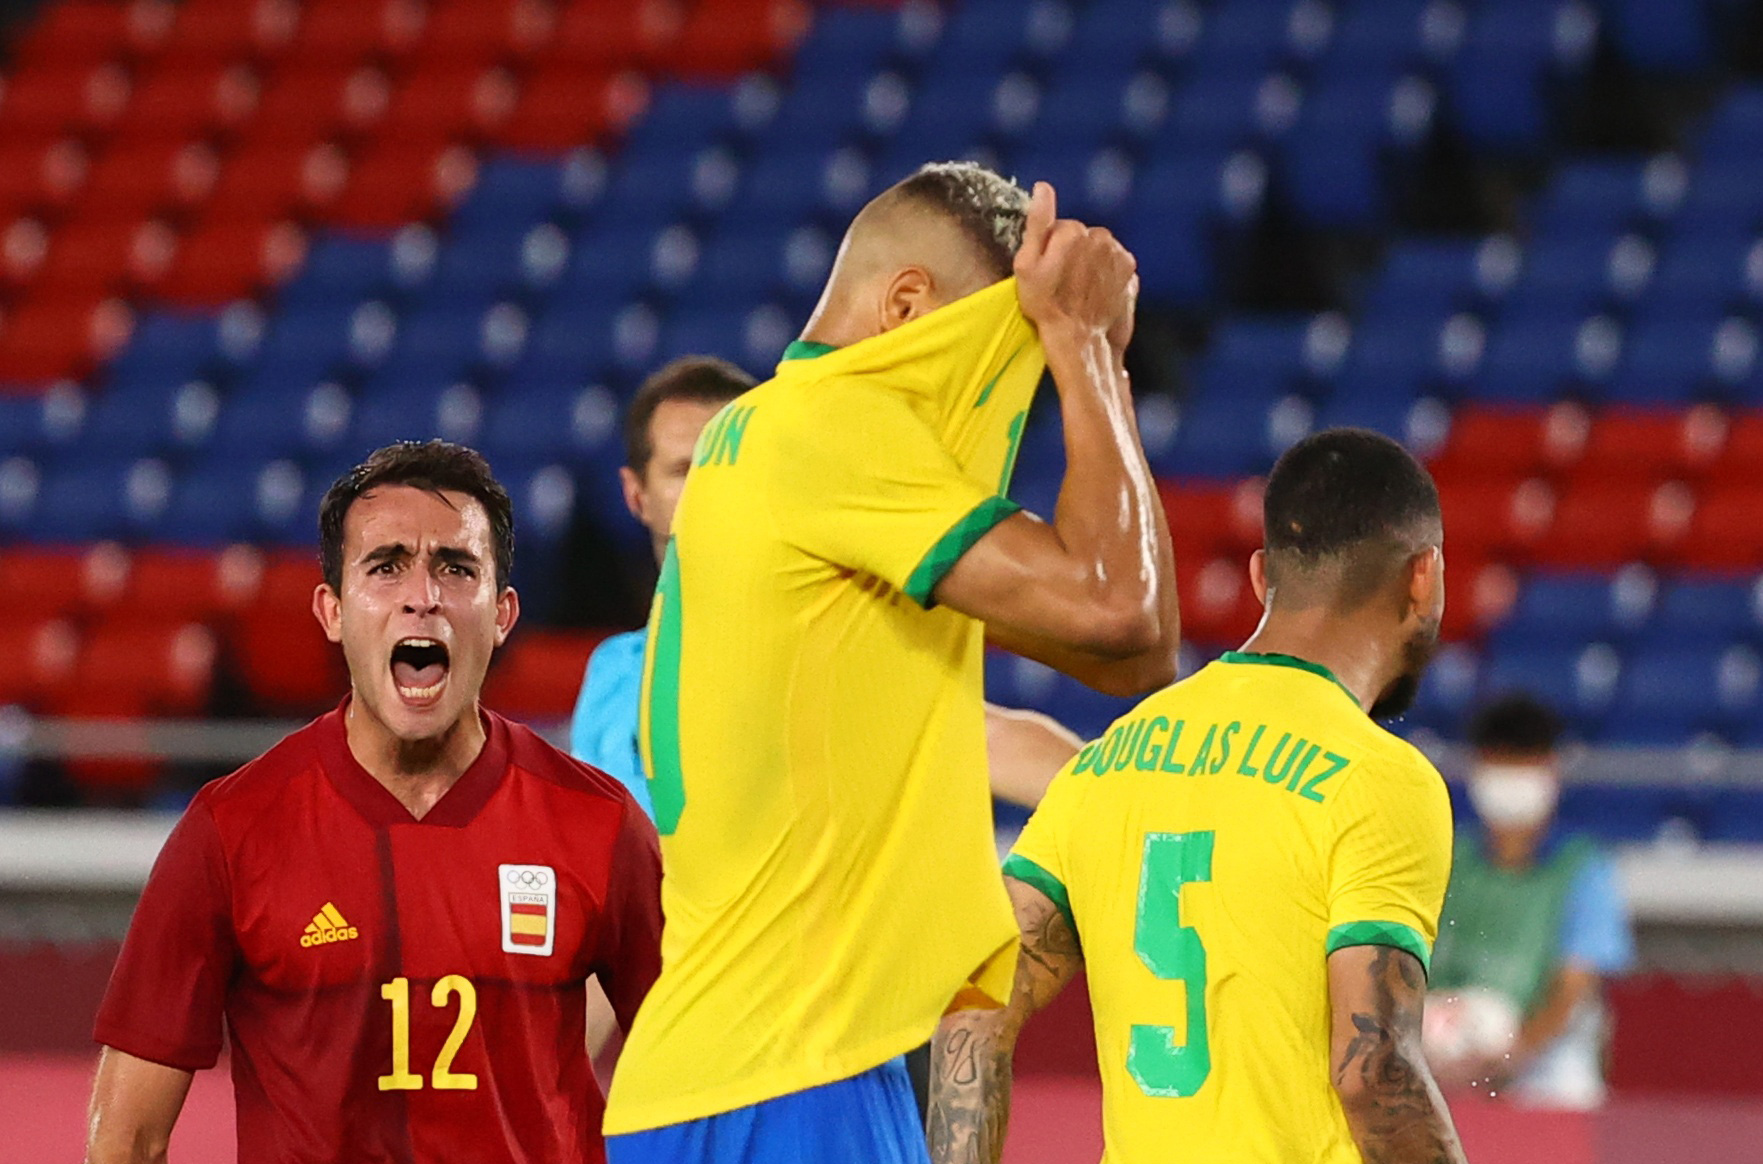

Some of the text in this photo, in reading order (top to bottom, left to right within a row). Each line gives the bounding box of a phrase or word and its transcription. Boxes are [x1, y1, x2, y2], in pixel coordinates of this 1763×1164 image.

[1070, 715, 1350, 804] DOUGLAS LUIZ
[300, 926, 358, 947] adidas
[1125, 830, 1216, 1098] 5
[378, 974, 478, 1091] 12
